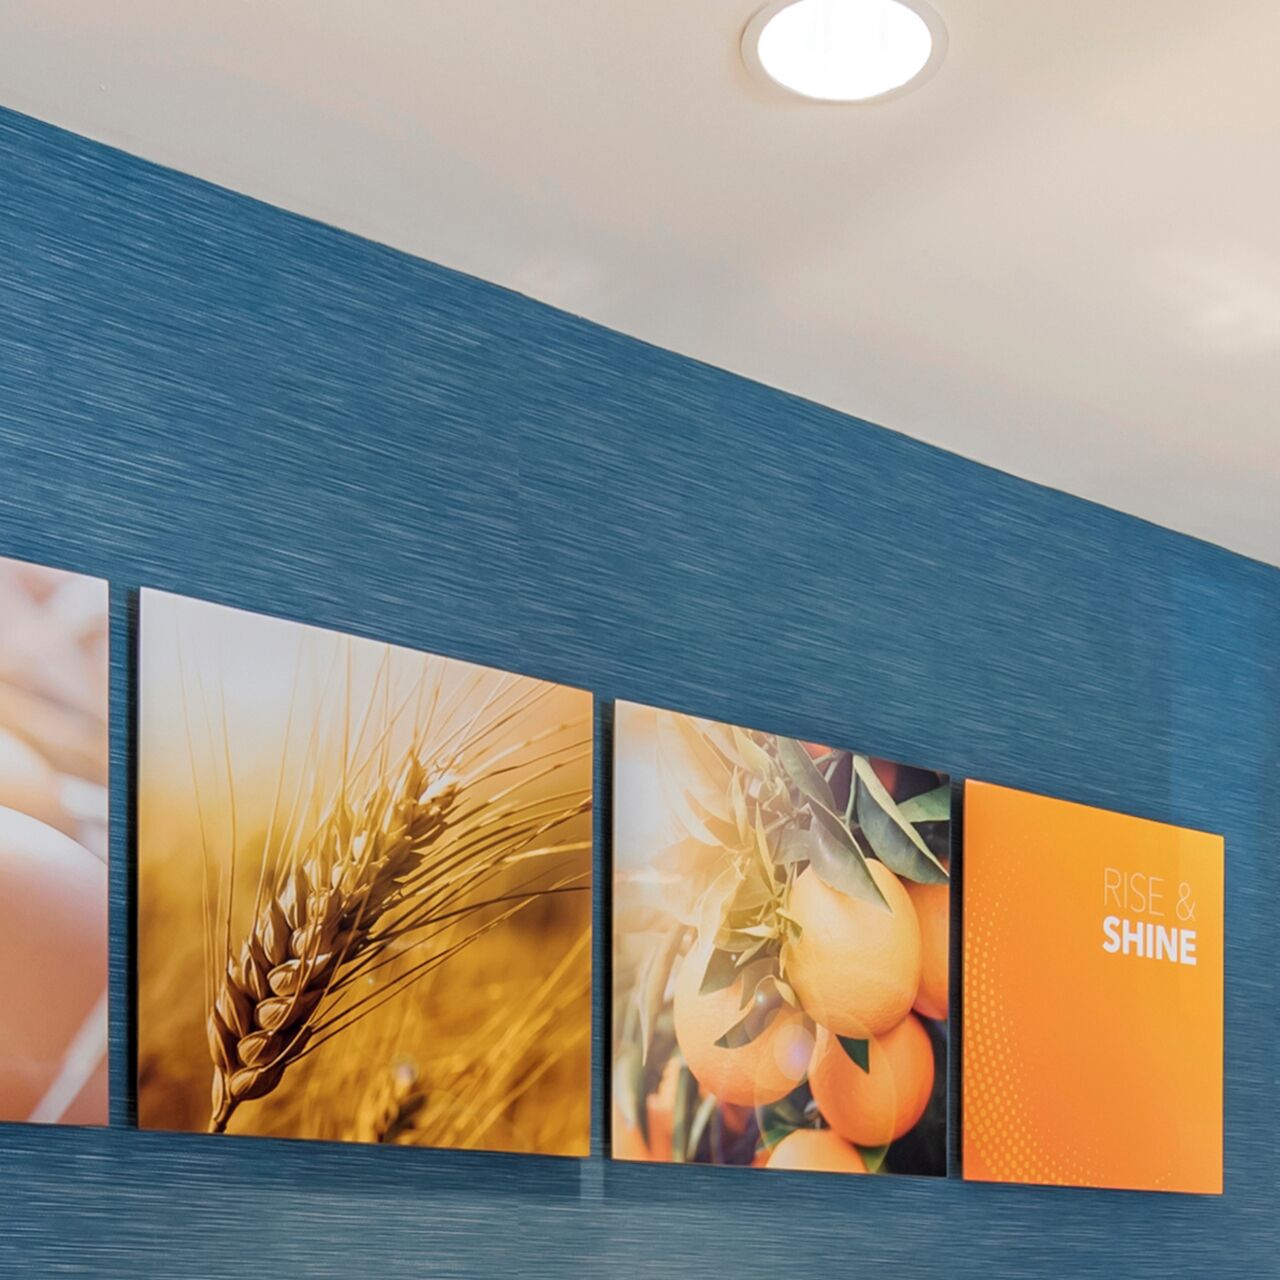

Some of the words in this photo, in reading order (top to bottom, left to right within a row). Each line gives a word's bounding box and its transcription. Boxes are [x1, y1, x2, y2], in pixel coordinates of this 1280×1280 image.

[1104, 867, 1165, 916] RISE
[1175, 881, 1196, 921] &
[1102, 915, 1197, 965] SHINE
